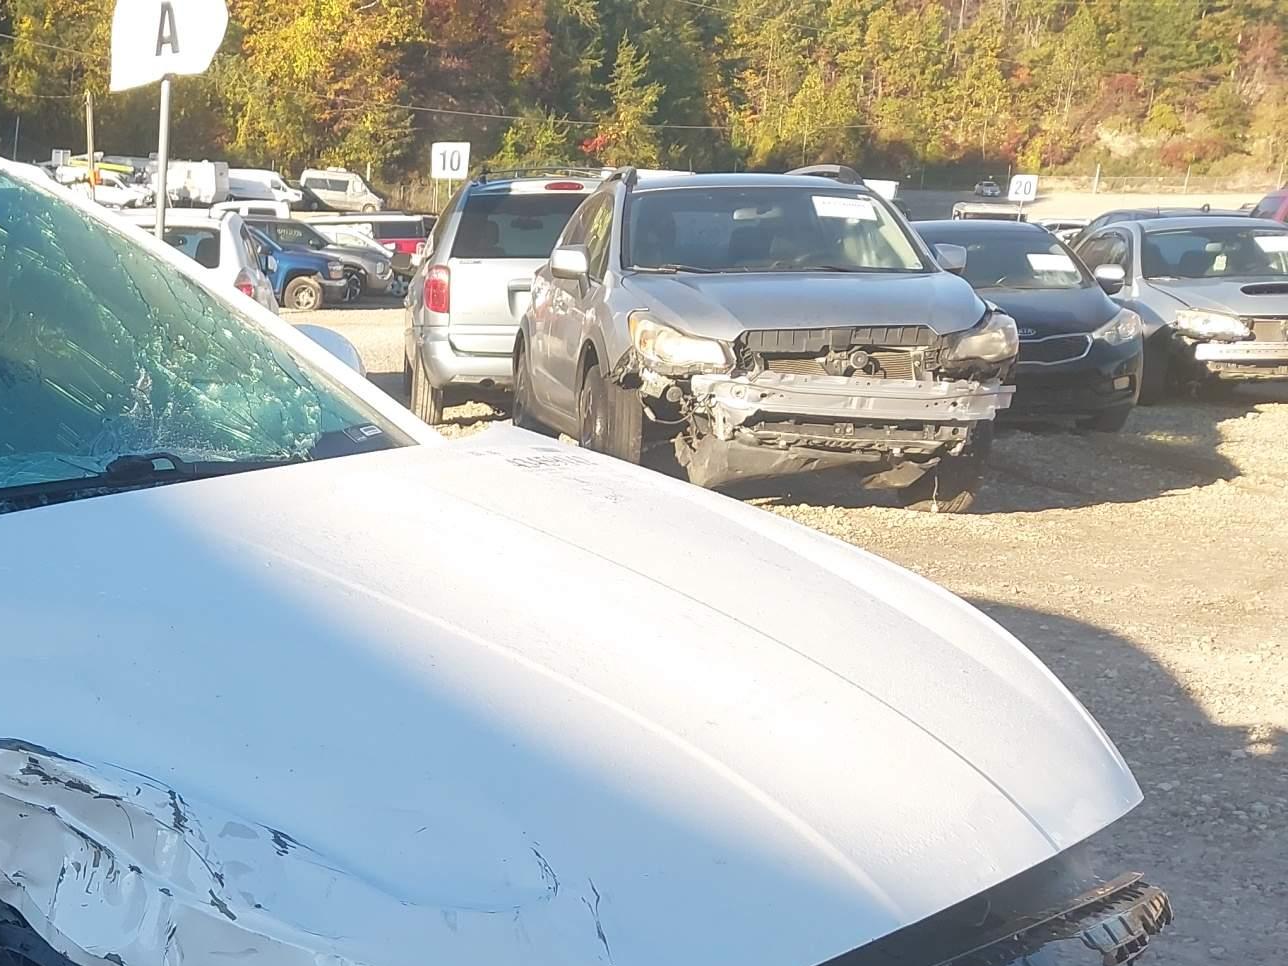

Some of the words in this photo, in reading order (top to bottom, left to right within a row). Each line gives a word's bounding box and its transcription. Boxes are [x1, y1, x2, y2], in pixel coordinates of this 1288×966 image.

[155, 1, 180, 56] A
[439, 150, 461, 171] 10
[1014, 180, 1032, 195] 20
